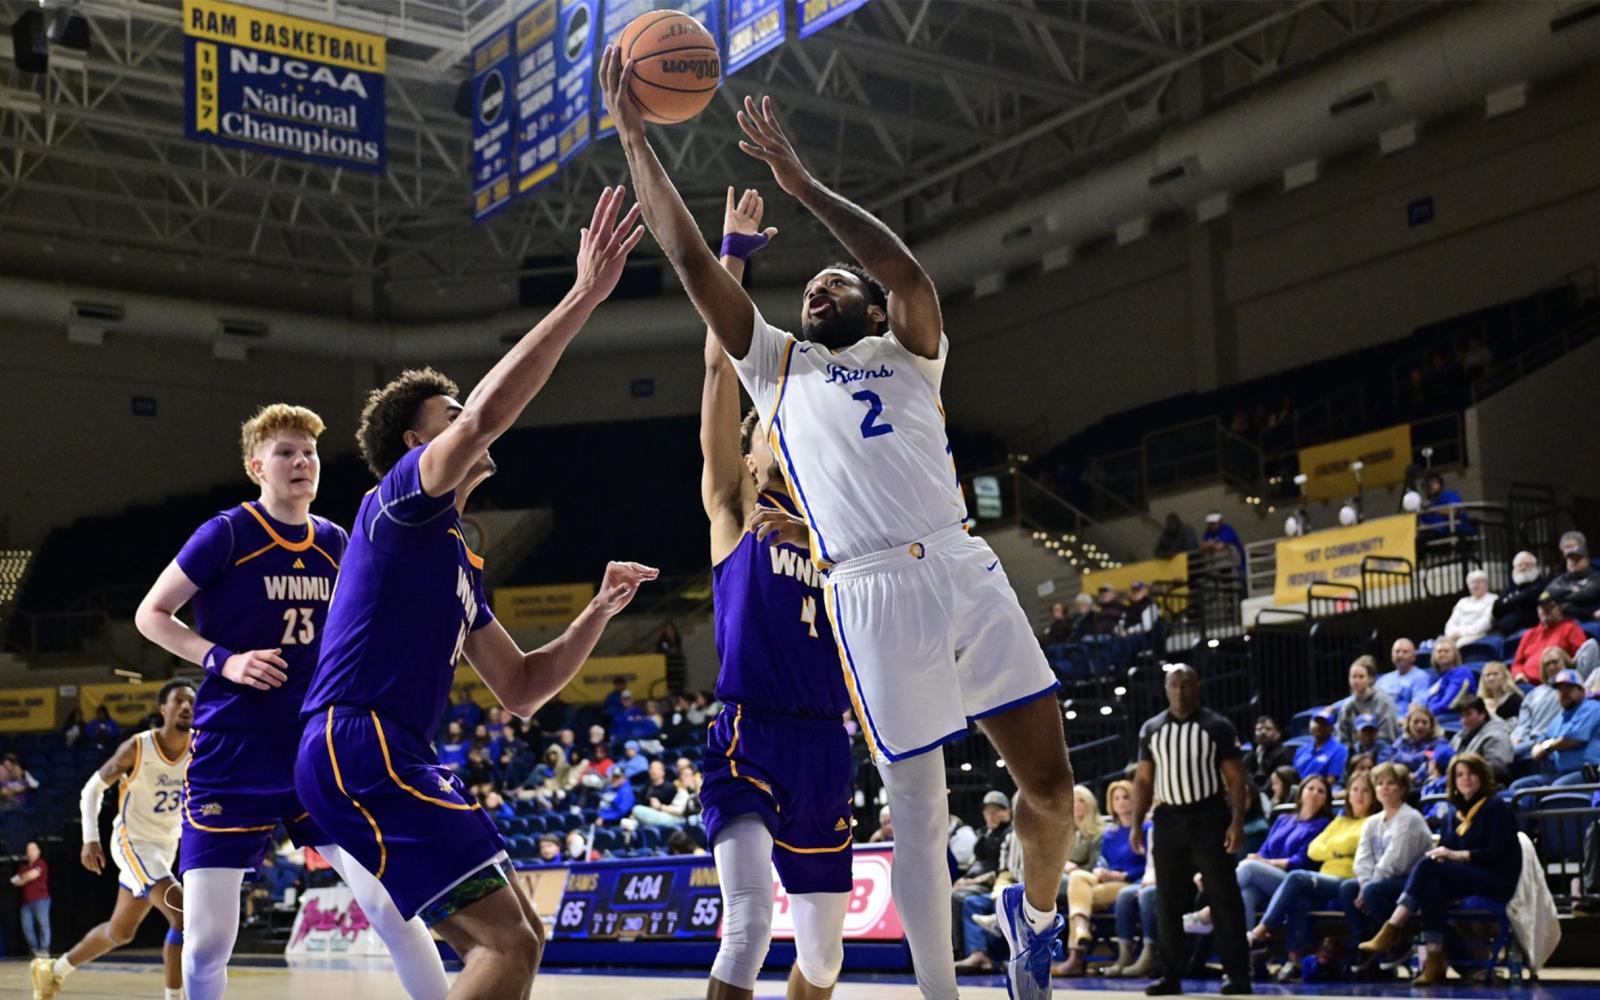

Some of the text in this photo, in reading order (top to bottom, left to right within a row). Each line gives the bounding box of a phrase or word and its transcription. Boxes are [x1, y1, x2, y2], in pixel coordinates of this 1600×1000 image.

[192, 8, 378, 66] RAM BASKETBALL
[202, 50, 214, 119] 1957
[230, 48, 368, 99] NJCAA
[662, 59, 720, 79] Wilson
[243, 85, 358, 129] National
[222, 111, 380, 161] Champions
[825, 363, 894, 384] Rams
[852, 389, 894, 439] 2
[1324, 536, 1384, 560] COMMUNITY
[263, 575, 330, 601] WNMU
[280, 608, 316, 645] 23
[800, 595, 819, 639] 4
[154, 790, 182, 813] 23
[624, 874, 664, 900] 4:04
[561, 901, 586, 927] 65
[691, 898, 721, 926] 55
